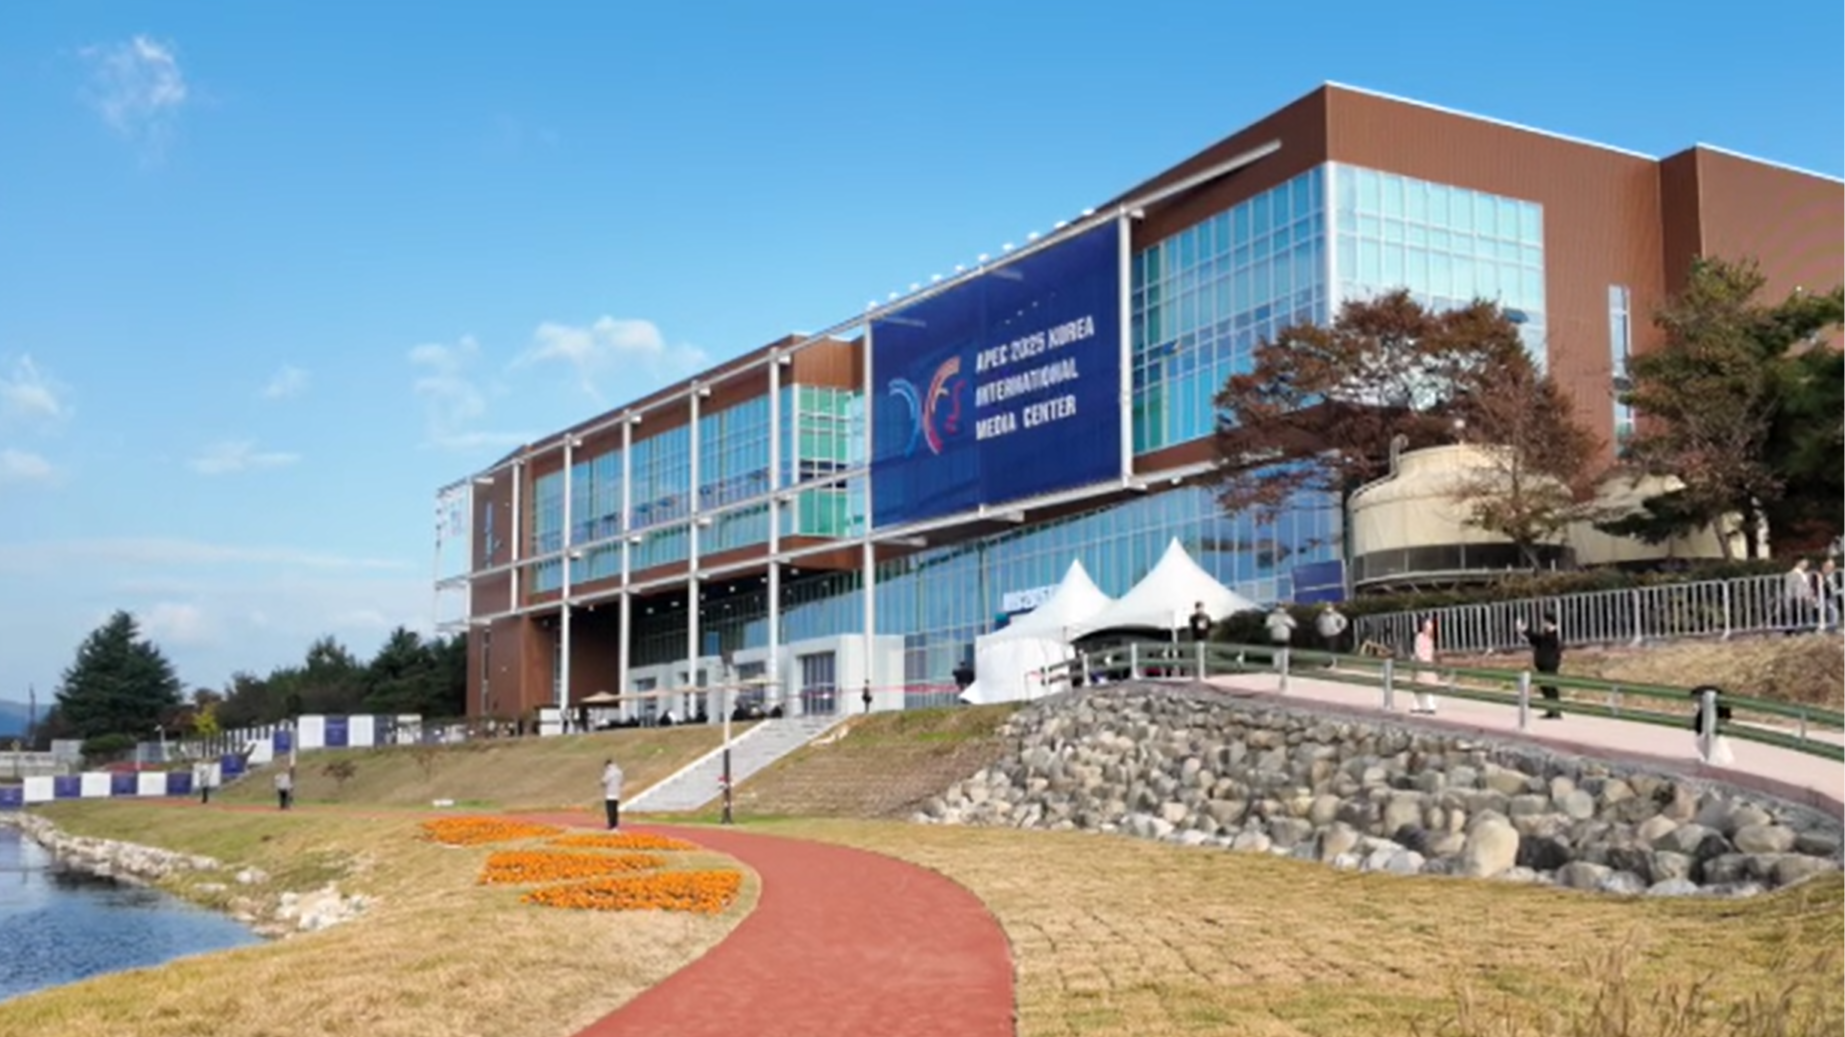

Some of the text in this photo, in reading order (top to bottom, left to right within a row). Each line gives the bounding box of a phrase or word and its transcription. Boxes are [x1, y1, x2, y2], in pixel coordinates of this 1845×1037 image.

[976, 315, 1095, 373] APEC 2025 KOREA
[976, 357, 1079, 407] INTERNATIONAL
[976, 395, 1077, 440] MEDIA CENTER
